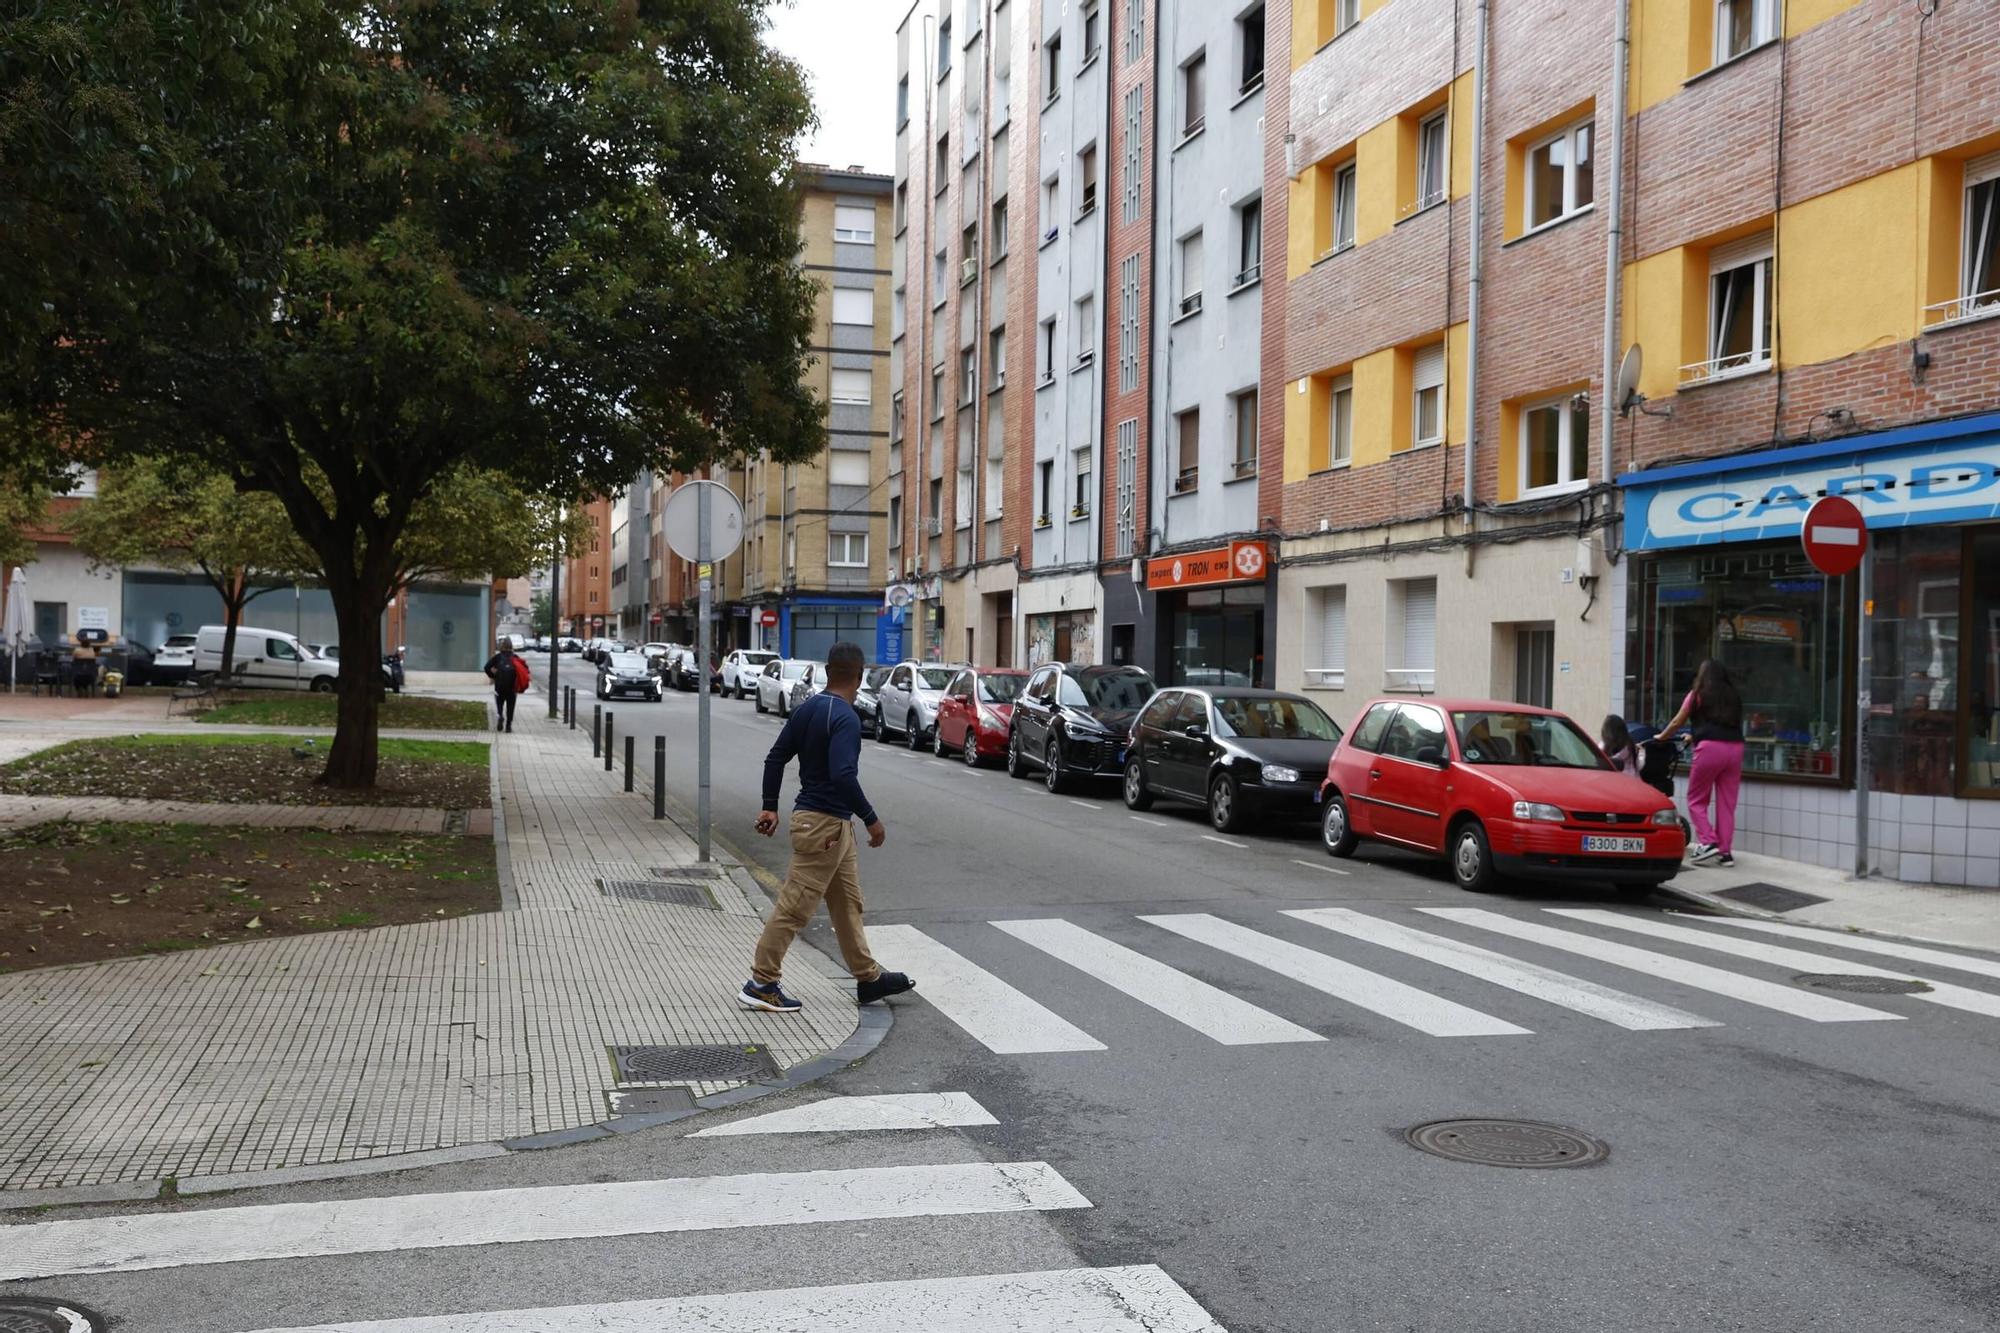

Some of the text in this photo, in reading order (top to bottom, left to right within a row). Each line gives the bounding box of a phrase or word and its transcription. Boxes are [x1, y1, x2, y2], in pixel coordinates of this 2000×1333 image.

[1188, 561, 1210, 576] TRON
[1589, 838, 1643, 851] 8300 BKN
